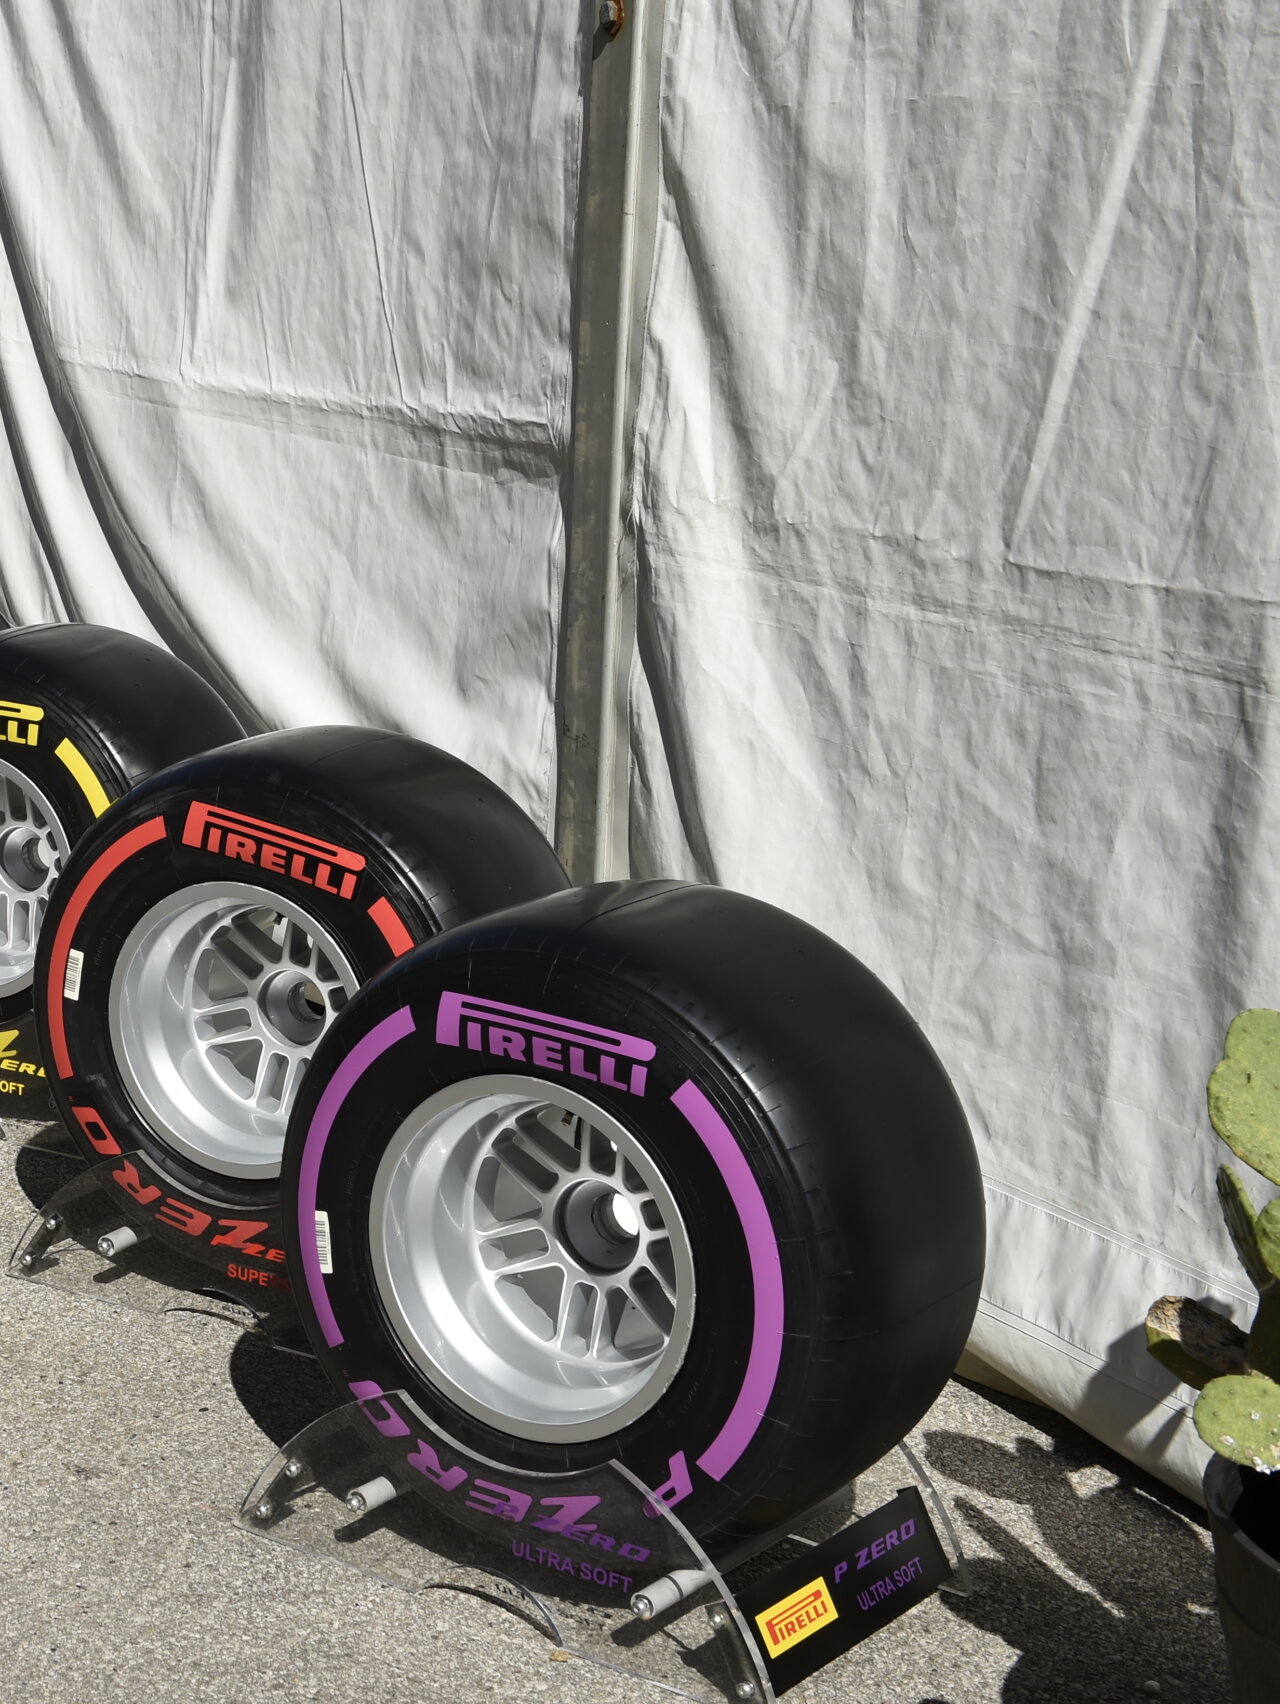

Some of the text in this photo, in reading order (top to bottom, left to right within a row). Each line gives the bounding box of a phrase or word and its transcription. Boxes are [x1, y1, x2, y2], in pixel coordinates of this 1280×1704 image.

[181, 800, 367, 900] PIRELLI
[435, 990, 658, 1097] PIRELLI
[71, 1106, 269, 1248] ZERO
[227, 1263, 272, 1287] SUPE
[241, 1242, 286, 1263] ZE
[348, 1380, 694, 1523] P ZERO
[511, 1539, 633, 1594] ULTRA SOFT
[530, 1514, 651, 1563] ZERO
[833, 1518, 916, 1585] P ZERO
[856, 1556, 924, 1612] ULTRA SOFT
[765, 1588, 829, 1646] PIRELLI
